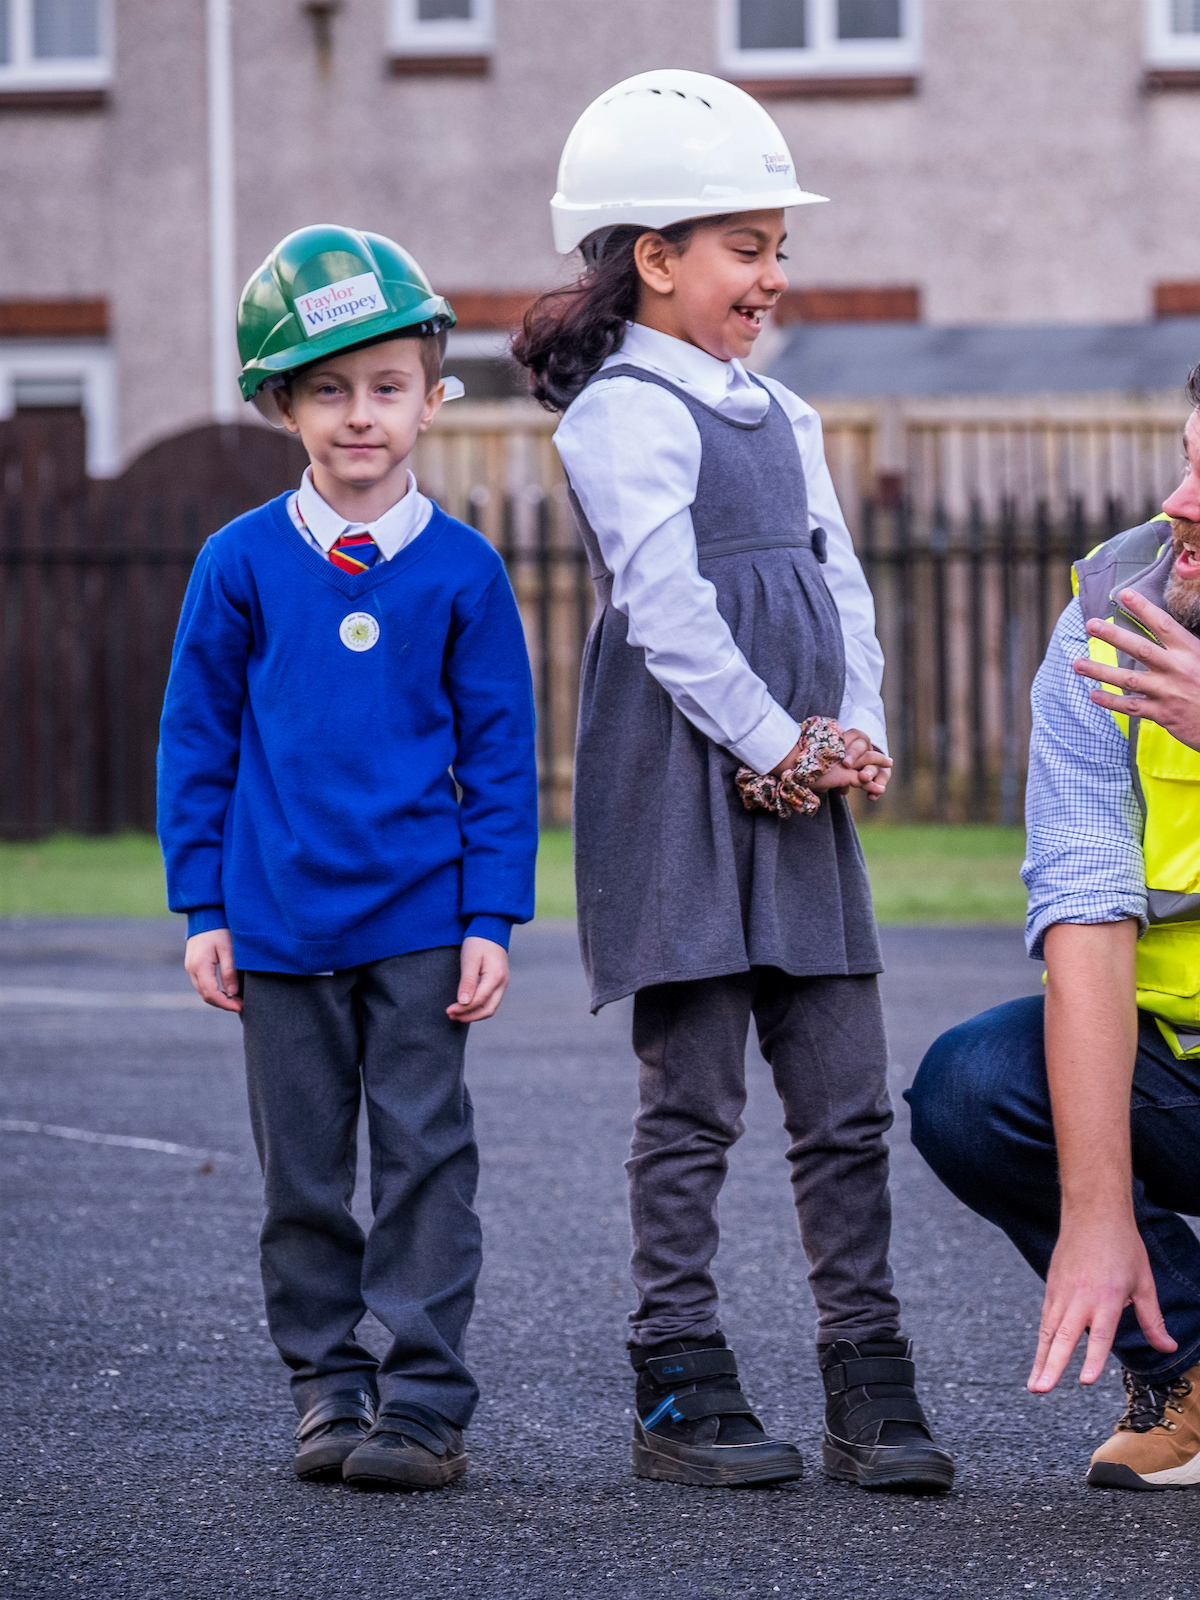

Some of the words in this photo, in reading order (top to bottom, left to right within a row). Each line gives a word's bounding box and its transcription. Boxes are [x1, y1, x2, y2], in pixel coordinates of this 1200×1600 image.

[762, 152, 785, 163] Taylor
[765, 164, 791, 175] Wimpe
[300, 283, 355, 312] Taylor
[306, 294, 377, 325] Wimpey
